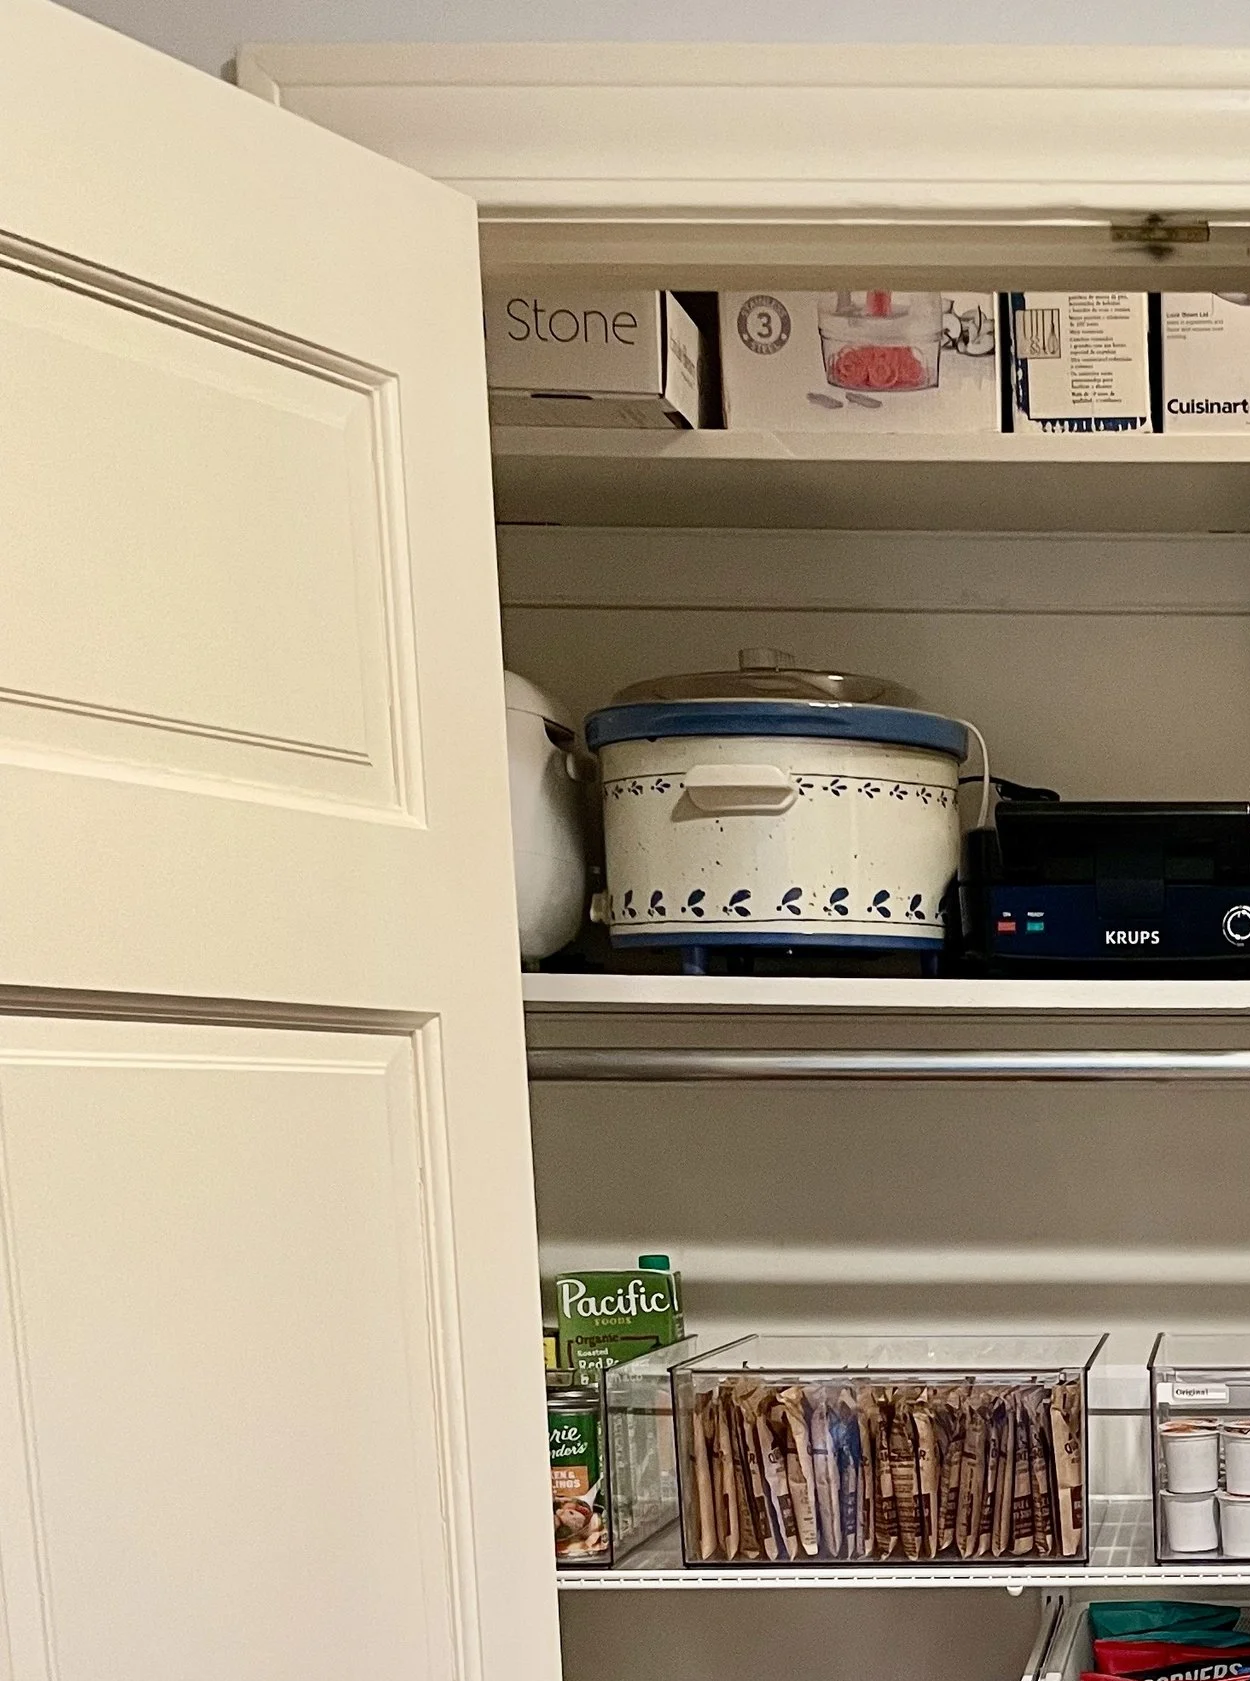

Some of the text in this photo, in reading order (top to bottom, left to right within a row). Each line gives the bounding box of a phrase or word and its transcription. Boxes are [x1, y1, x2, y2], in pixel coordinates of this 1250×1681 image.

[505, 298, 639, 346] Stone
[757, 312, 773, 338] 3
[1166, 398, 1250, 415] Cuisinart
[1105, 930, 1160, 945] KRUPS
[557, 1278, 671, 1320] Pacific
[593, 1316, 633, 1326] FOODS
[575, 1334, 620, 1348] Organic
[576, 1347, 609, 1357] Roasted
[1175, 1388, 1209, 1397] Original
[549, 1425, 582, 1444] rie
